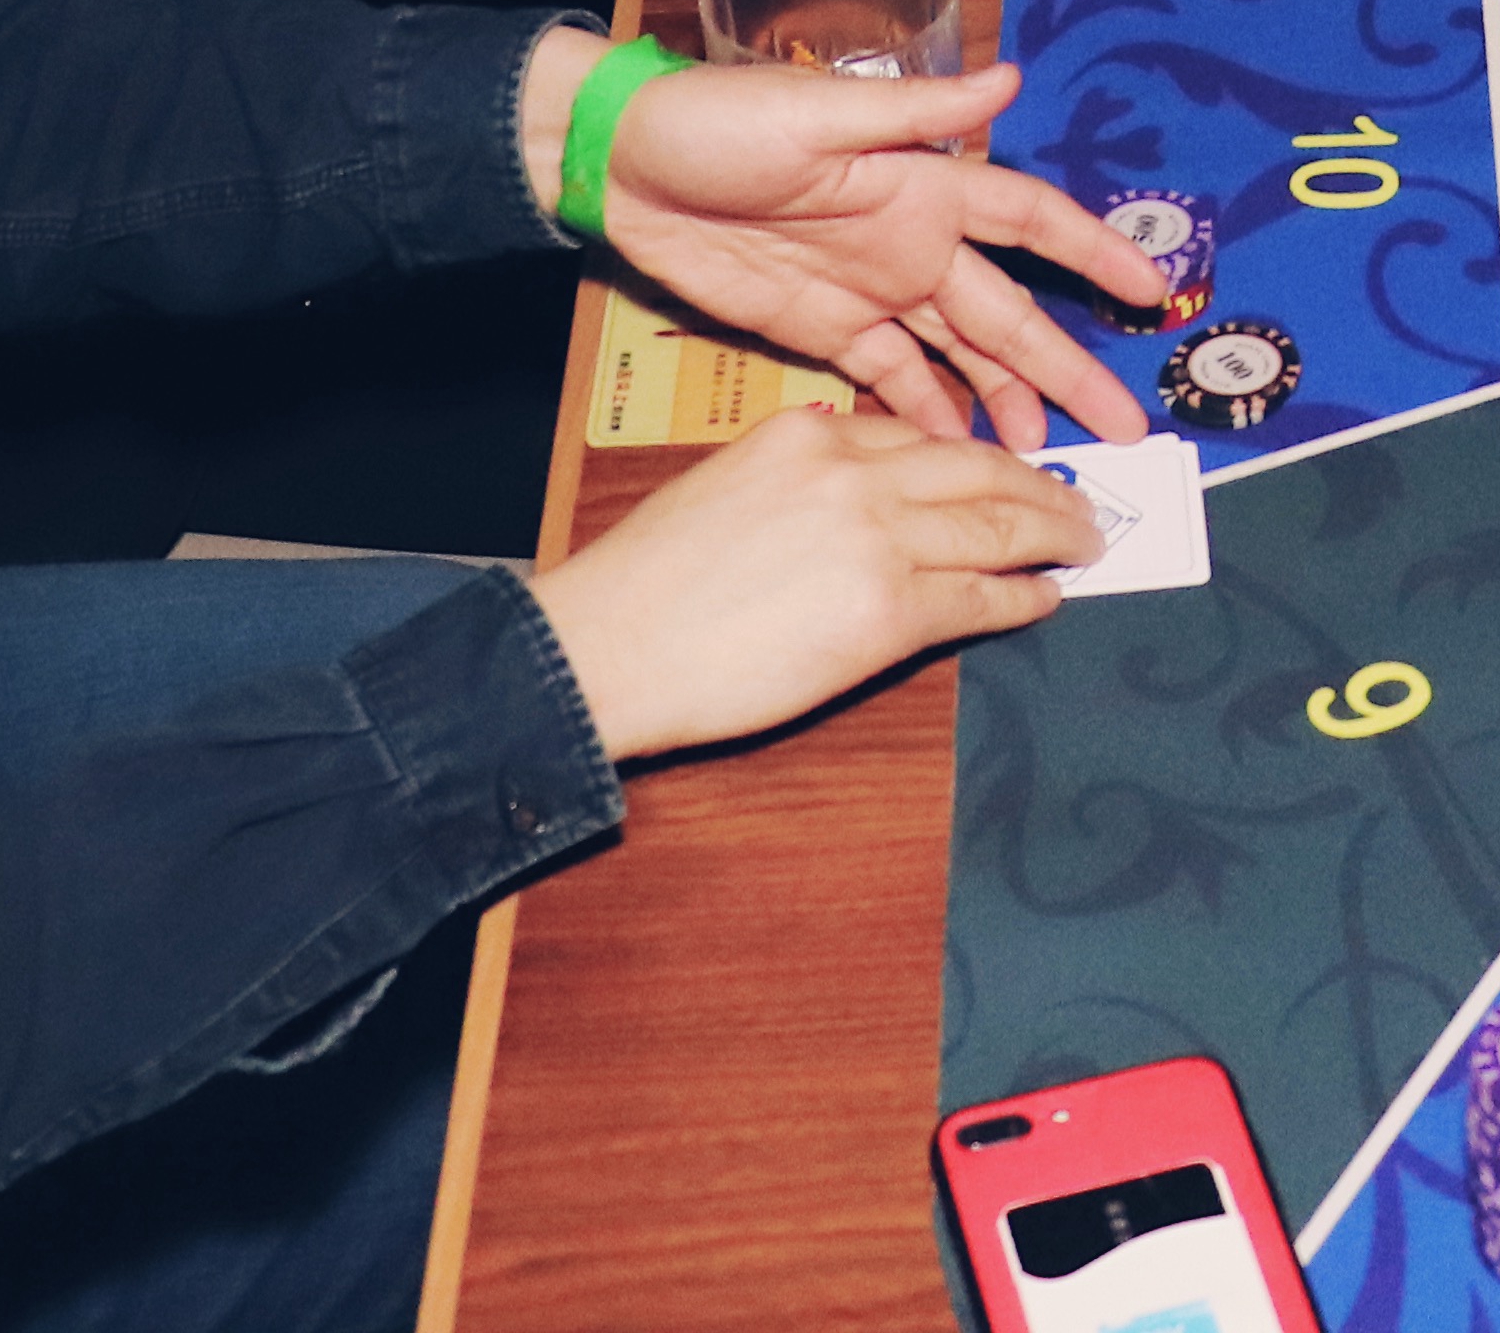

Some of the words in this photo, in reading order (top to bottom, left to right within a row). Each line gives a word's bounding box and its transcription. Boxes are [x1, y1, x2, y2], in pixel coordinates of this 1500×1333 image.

[1288, 115, 1400, 210] 10
[1216, 351, 1255, 380] 100
[1306, 660, 1433, 740] 9
